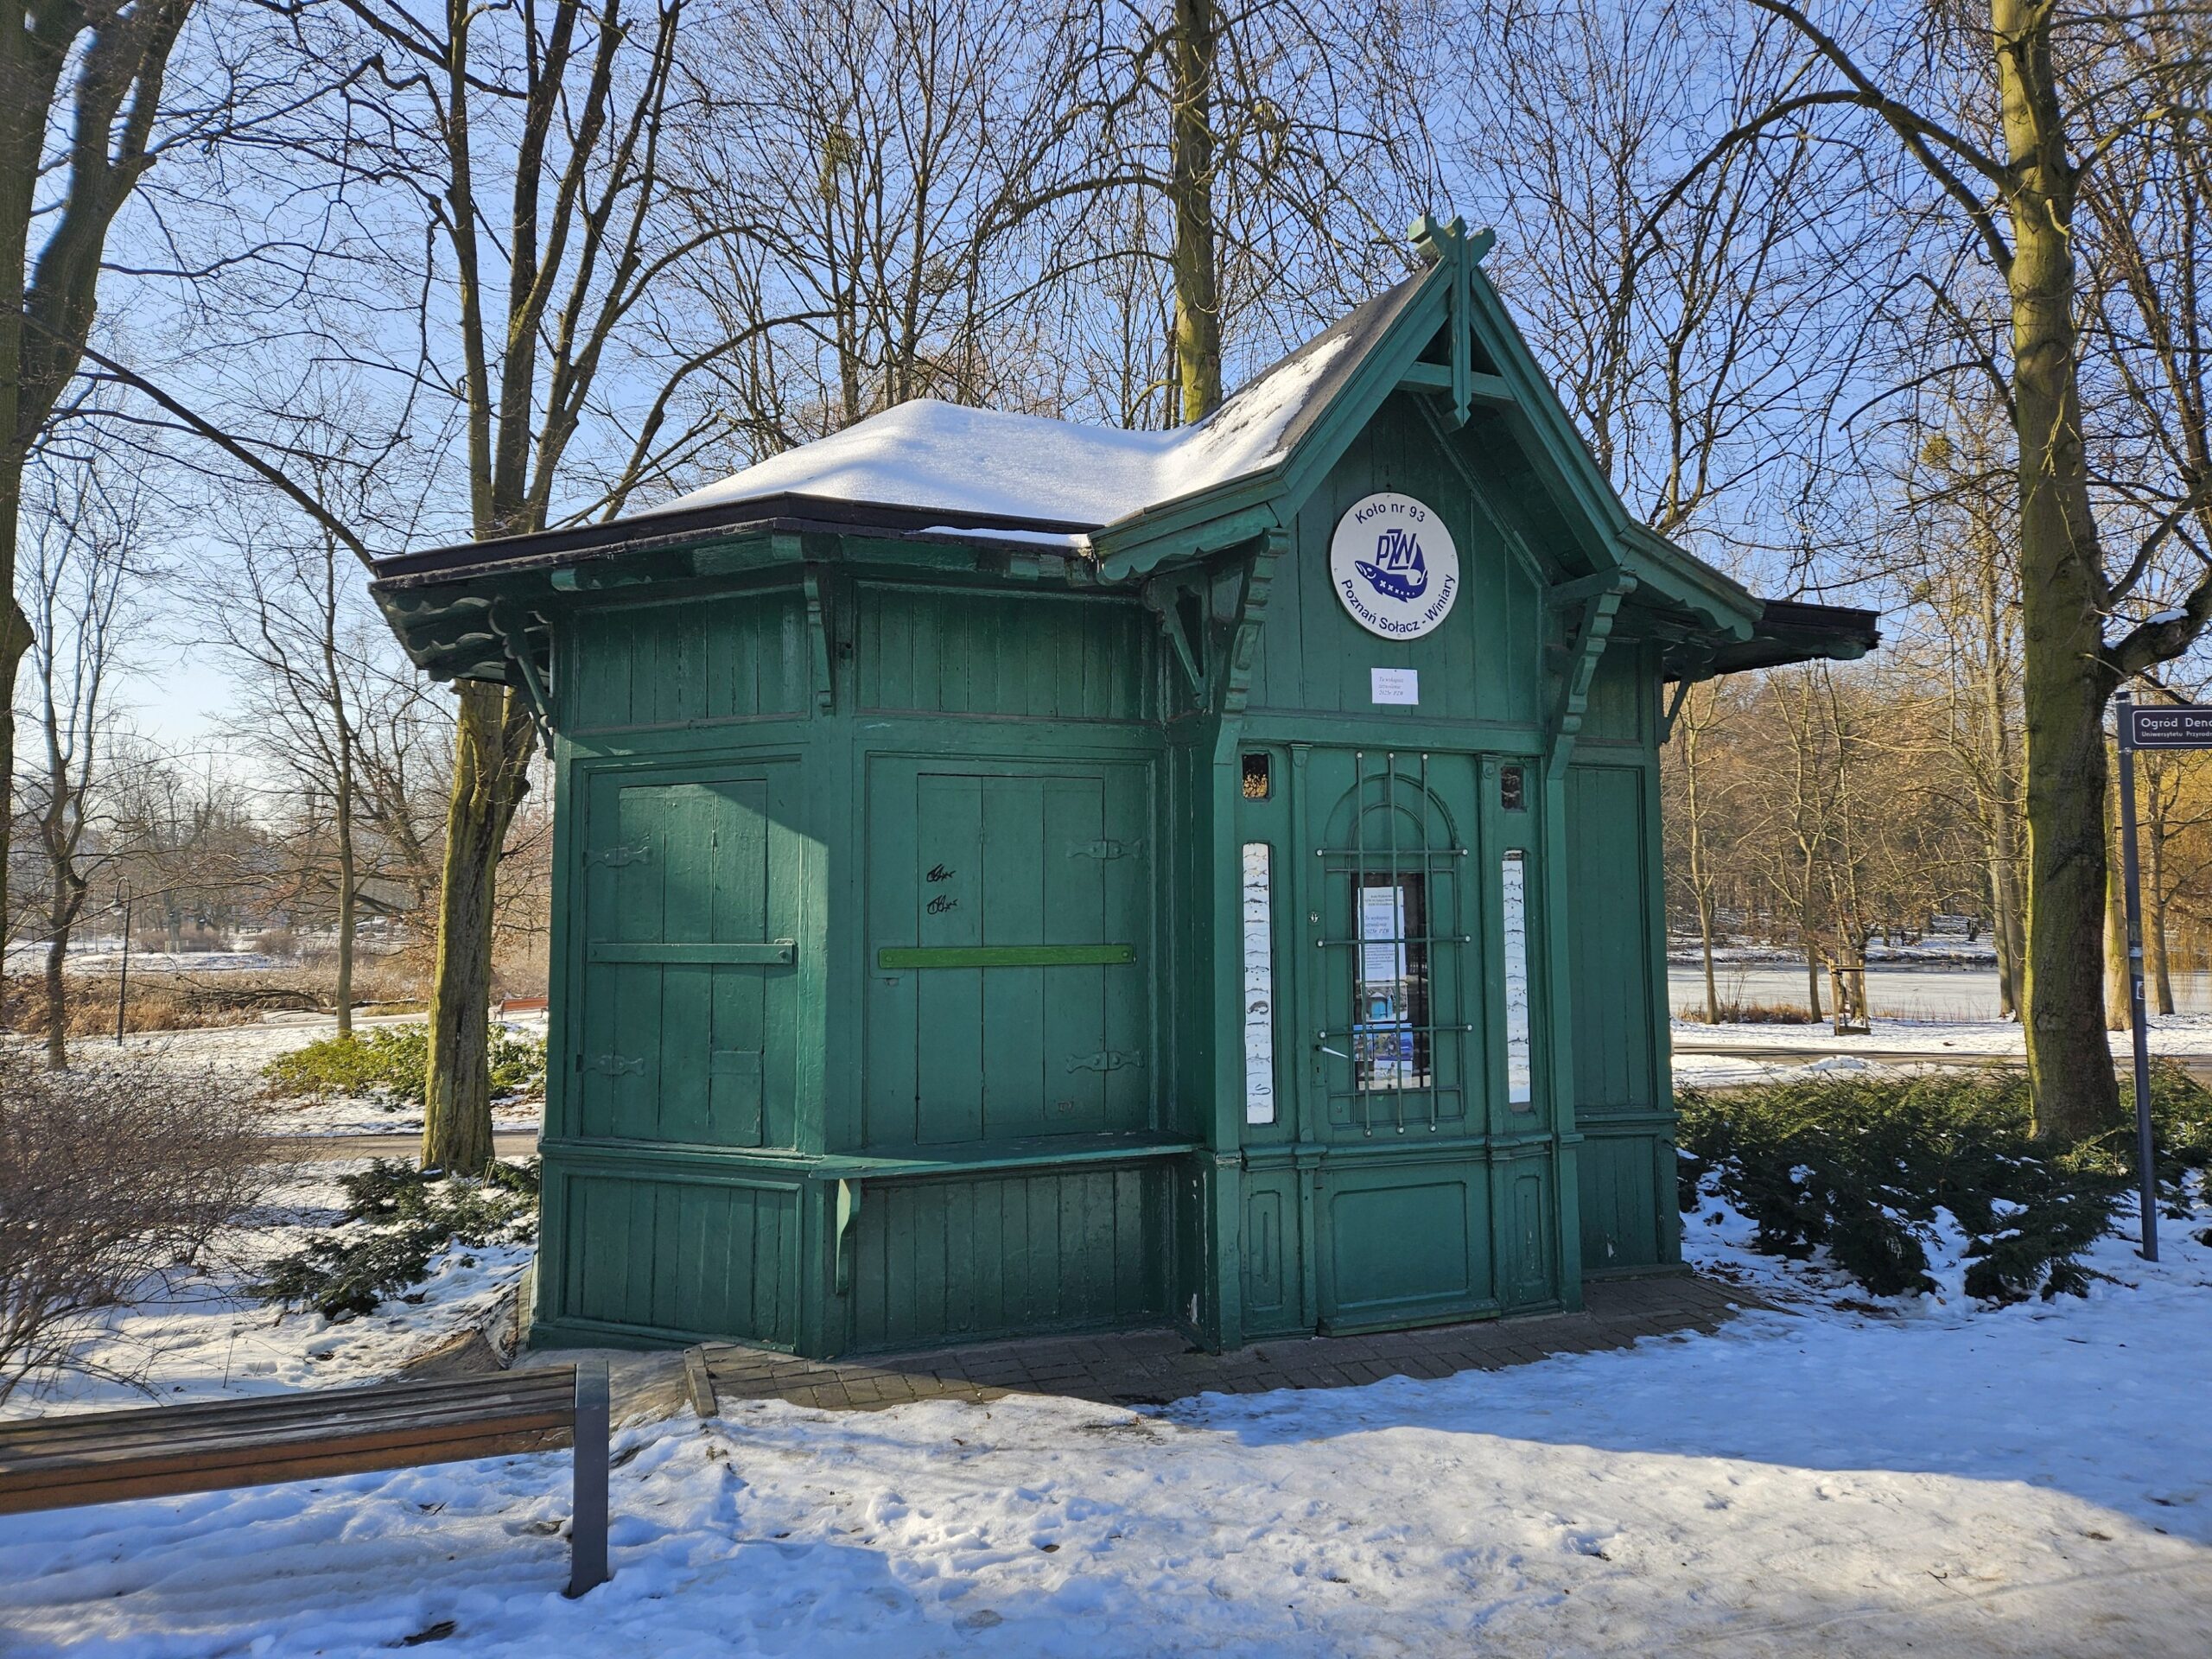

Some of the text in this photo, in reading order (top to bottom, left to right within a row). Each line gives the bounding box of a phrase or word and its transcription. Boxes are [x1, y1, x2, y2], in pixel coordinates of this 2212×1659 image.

[1355, 503, 1426, 524] Koło nr 93
[1376, 529, 1416, 570] PZW
[1341, 579, 1376, 625] Poznań
[1379, 617, 1420, 632] Sołacz
[1424, 574, 1455, 621] Winiary
[2141, 717, 2177, 730] Ogród
